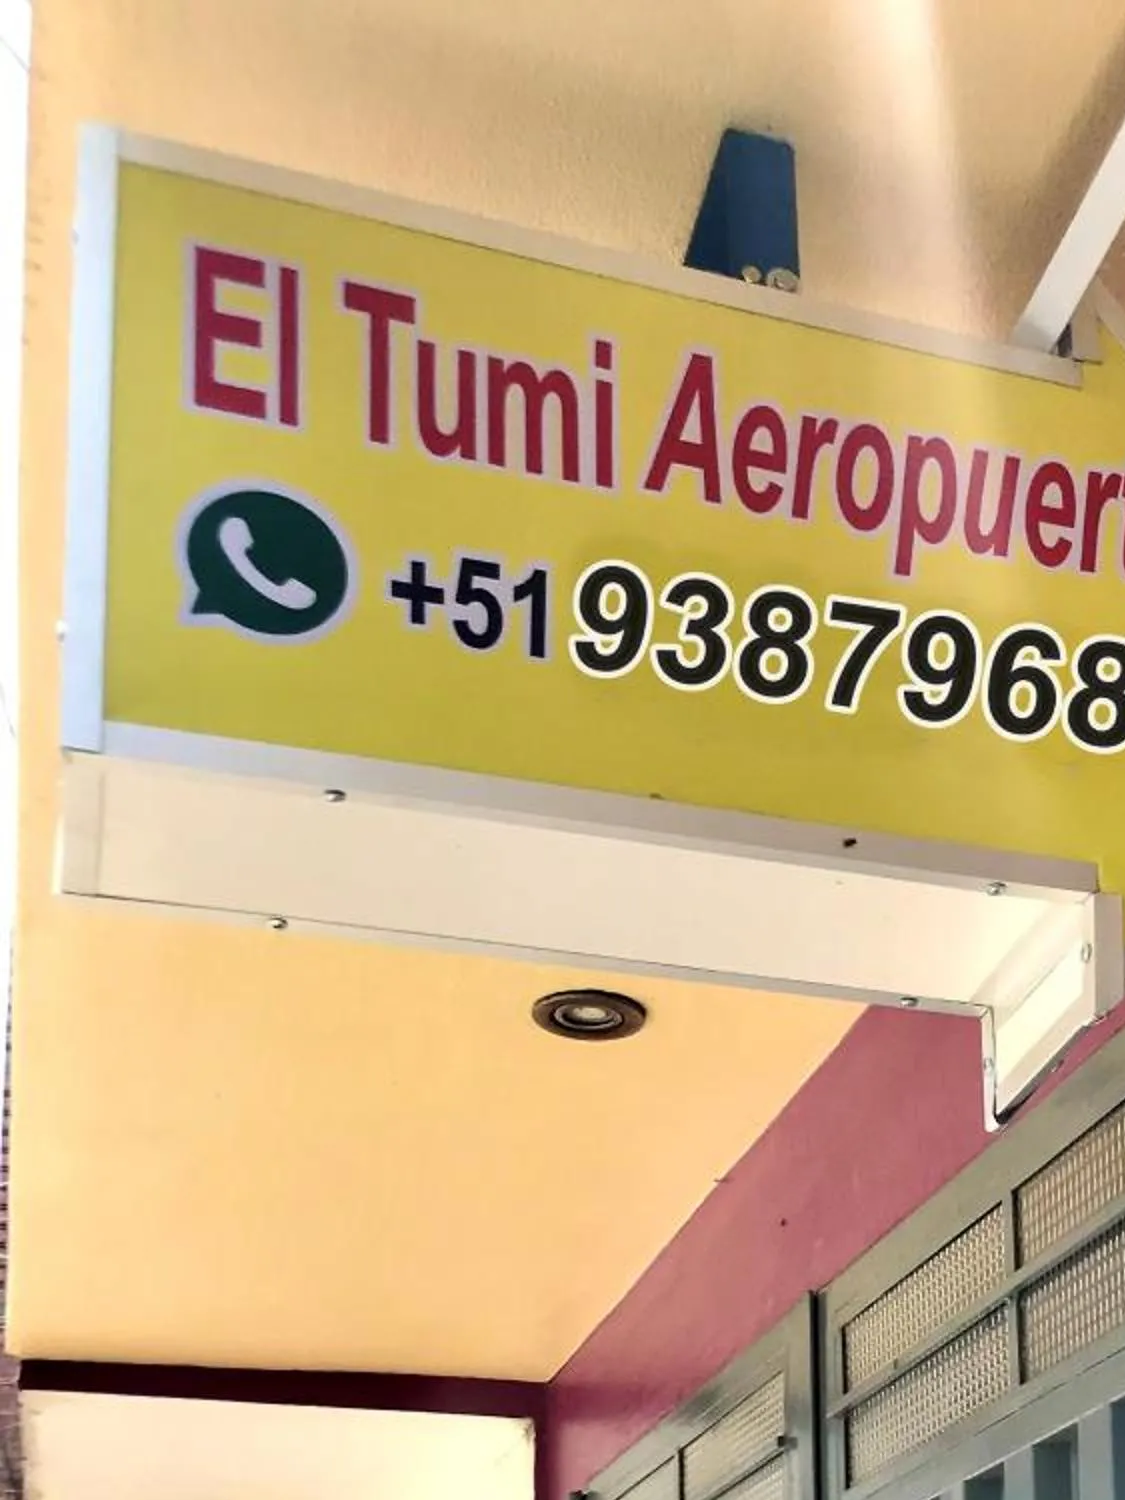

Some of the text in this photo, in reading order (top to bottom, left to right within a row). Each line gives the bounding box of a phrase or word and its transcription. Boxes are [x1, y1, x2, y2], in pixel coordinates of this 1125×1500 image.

[192, 245, 299, 427] El
[342, 281, 615, 490] Tumi
[391, 556, 550, 659] +51
